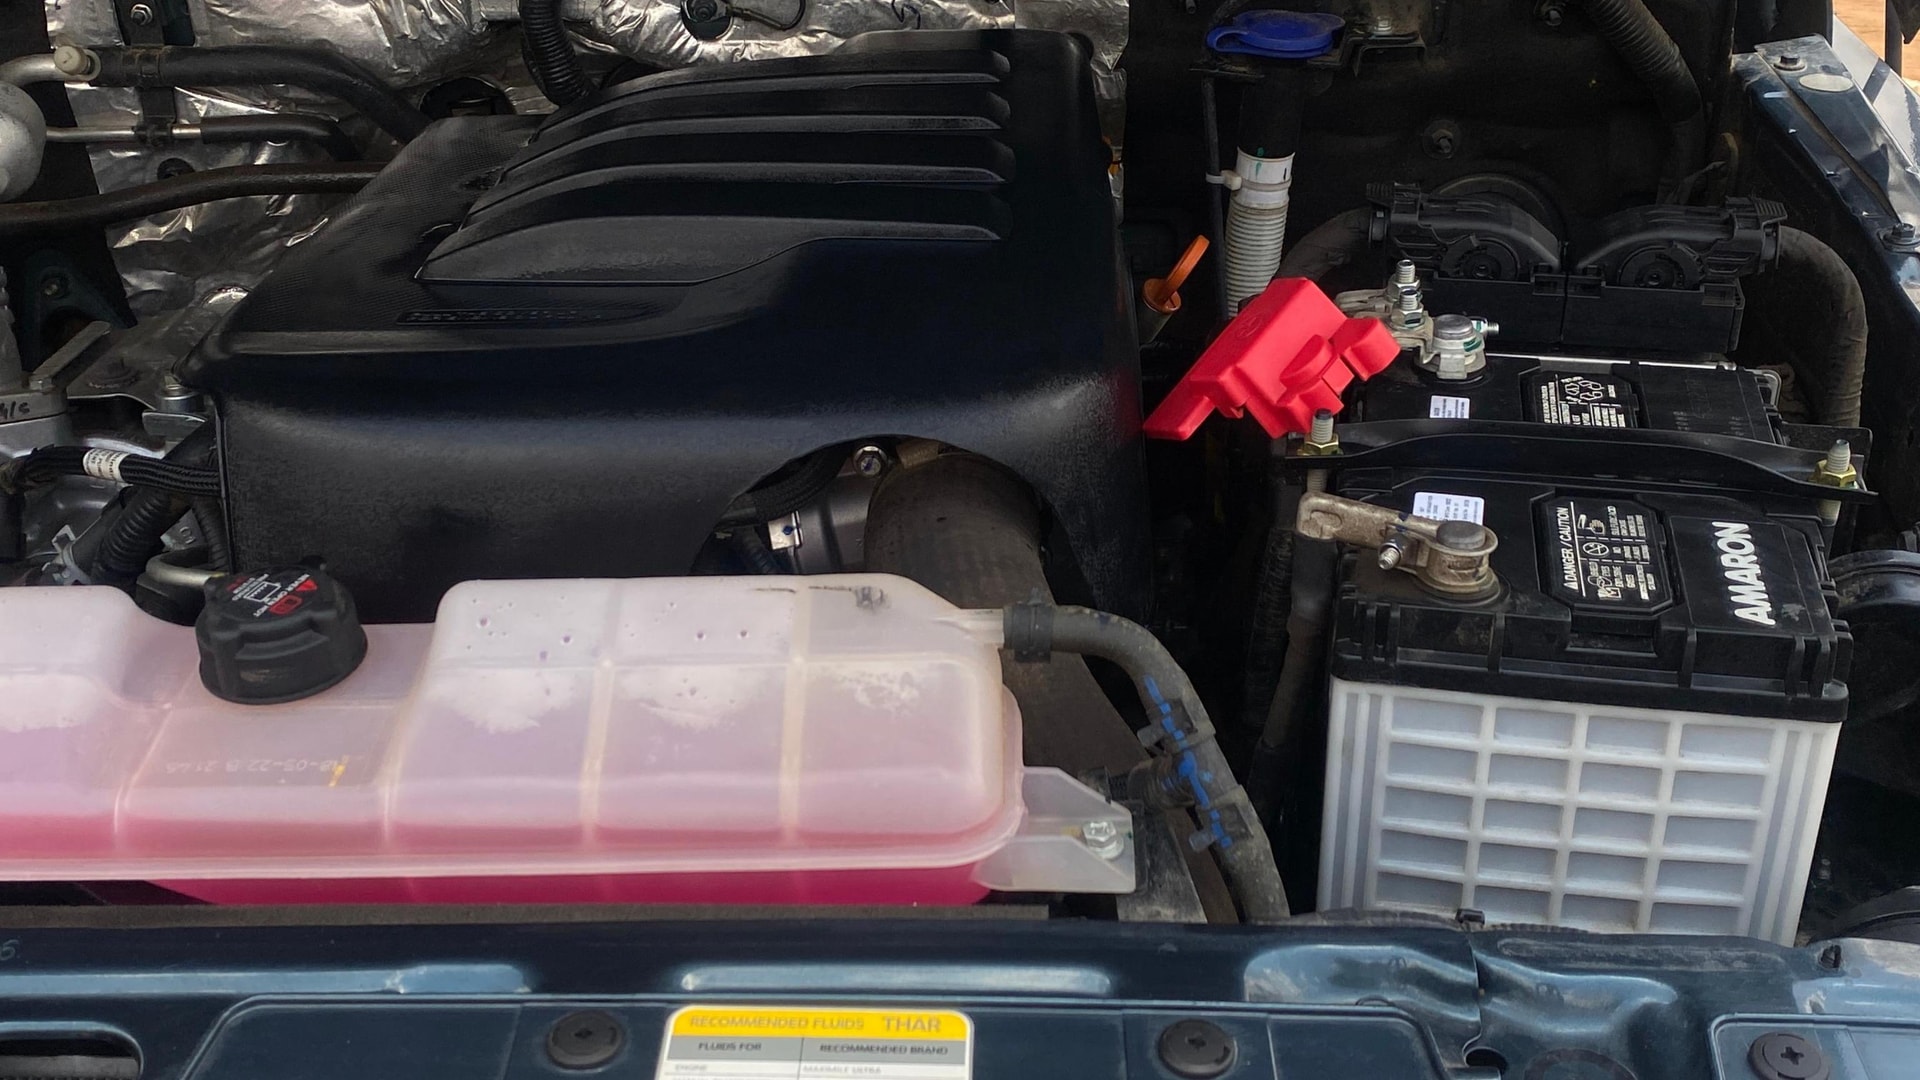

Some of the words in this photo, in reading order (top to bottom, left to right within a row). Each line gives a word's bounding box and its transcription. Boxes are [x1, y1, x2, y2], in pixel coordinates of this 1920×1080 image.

[1557, 506, 1572, 540] CAUTION
[1560, 547, 1579, 582] DANGER
[1711, 521, 1776, 625] AMARON
[690, 1015, 808, 1029] RECOMMENDED
[812, 1017, 864, 1031] FLUIDS
[882, 1016, 942, 1033] THAR
[698, 1042, 737, 1052] FLUIDS
[739, 1042, 762, 1052] FOR
[819, 1044, 907, 1055] RECOMMENDED
[910, 1046, 949, 1056] BRAND
